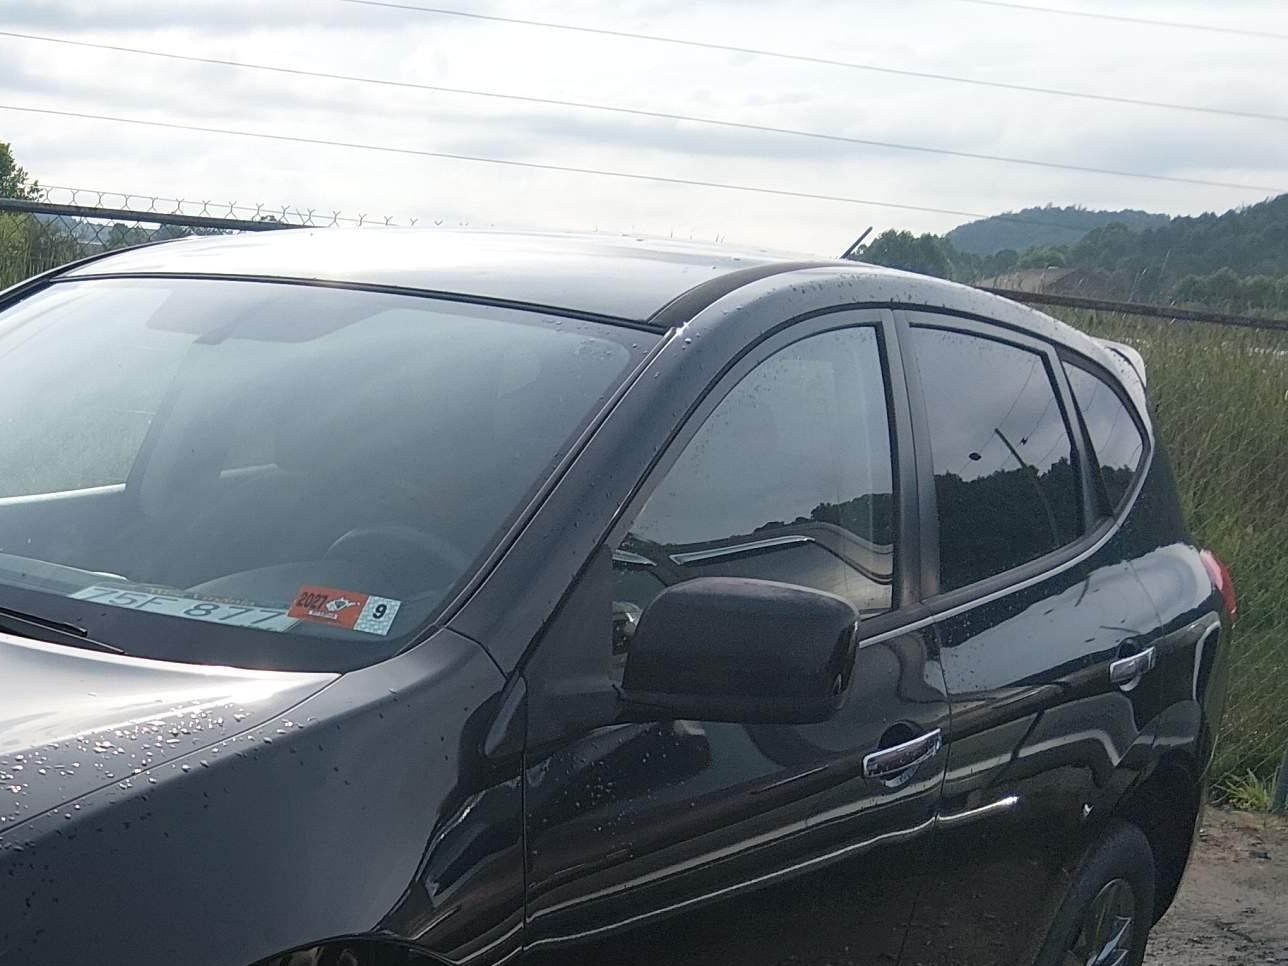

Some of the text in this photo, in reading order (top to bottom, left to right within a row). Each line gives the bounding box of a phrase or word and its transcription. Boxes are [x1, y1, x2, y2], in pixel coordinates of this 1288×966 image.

[85, 587, 179, 609] 75F
[183, 602, 283, 625] 877
[295, 591, 328, 610] 2027
[372, 603, 388, 620] 9
